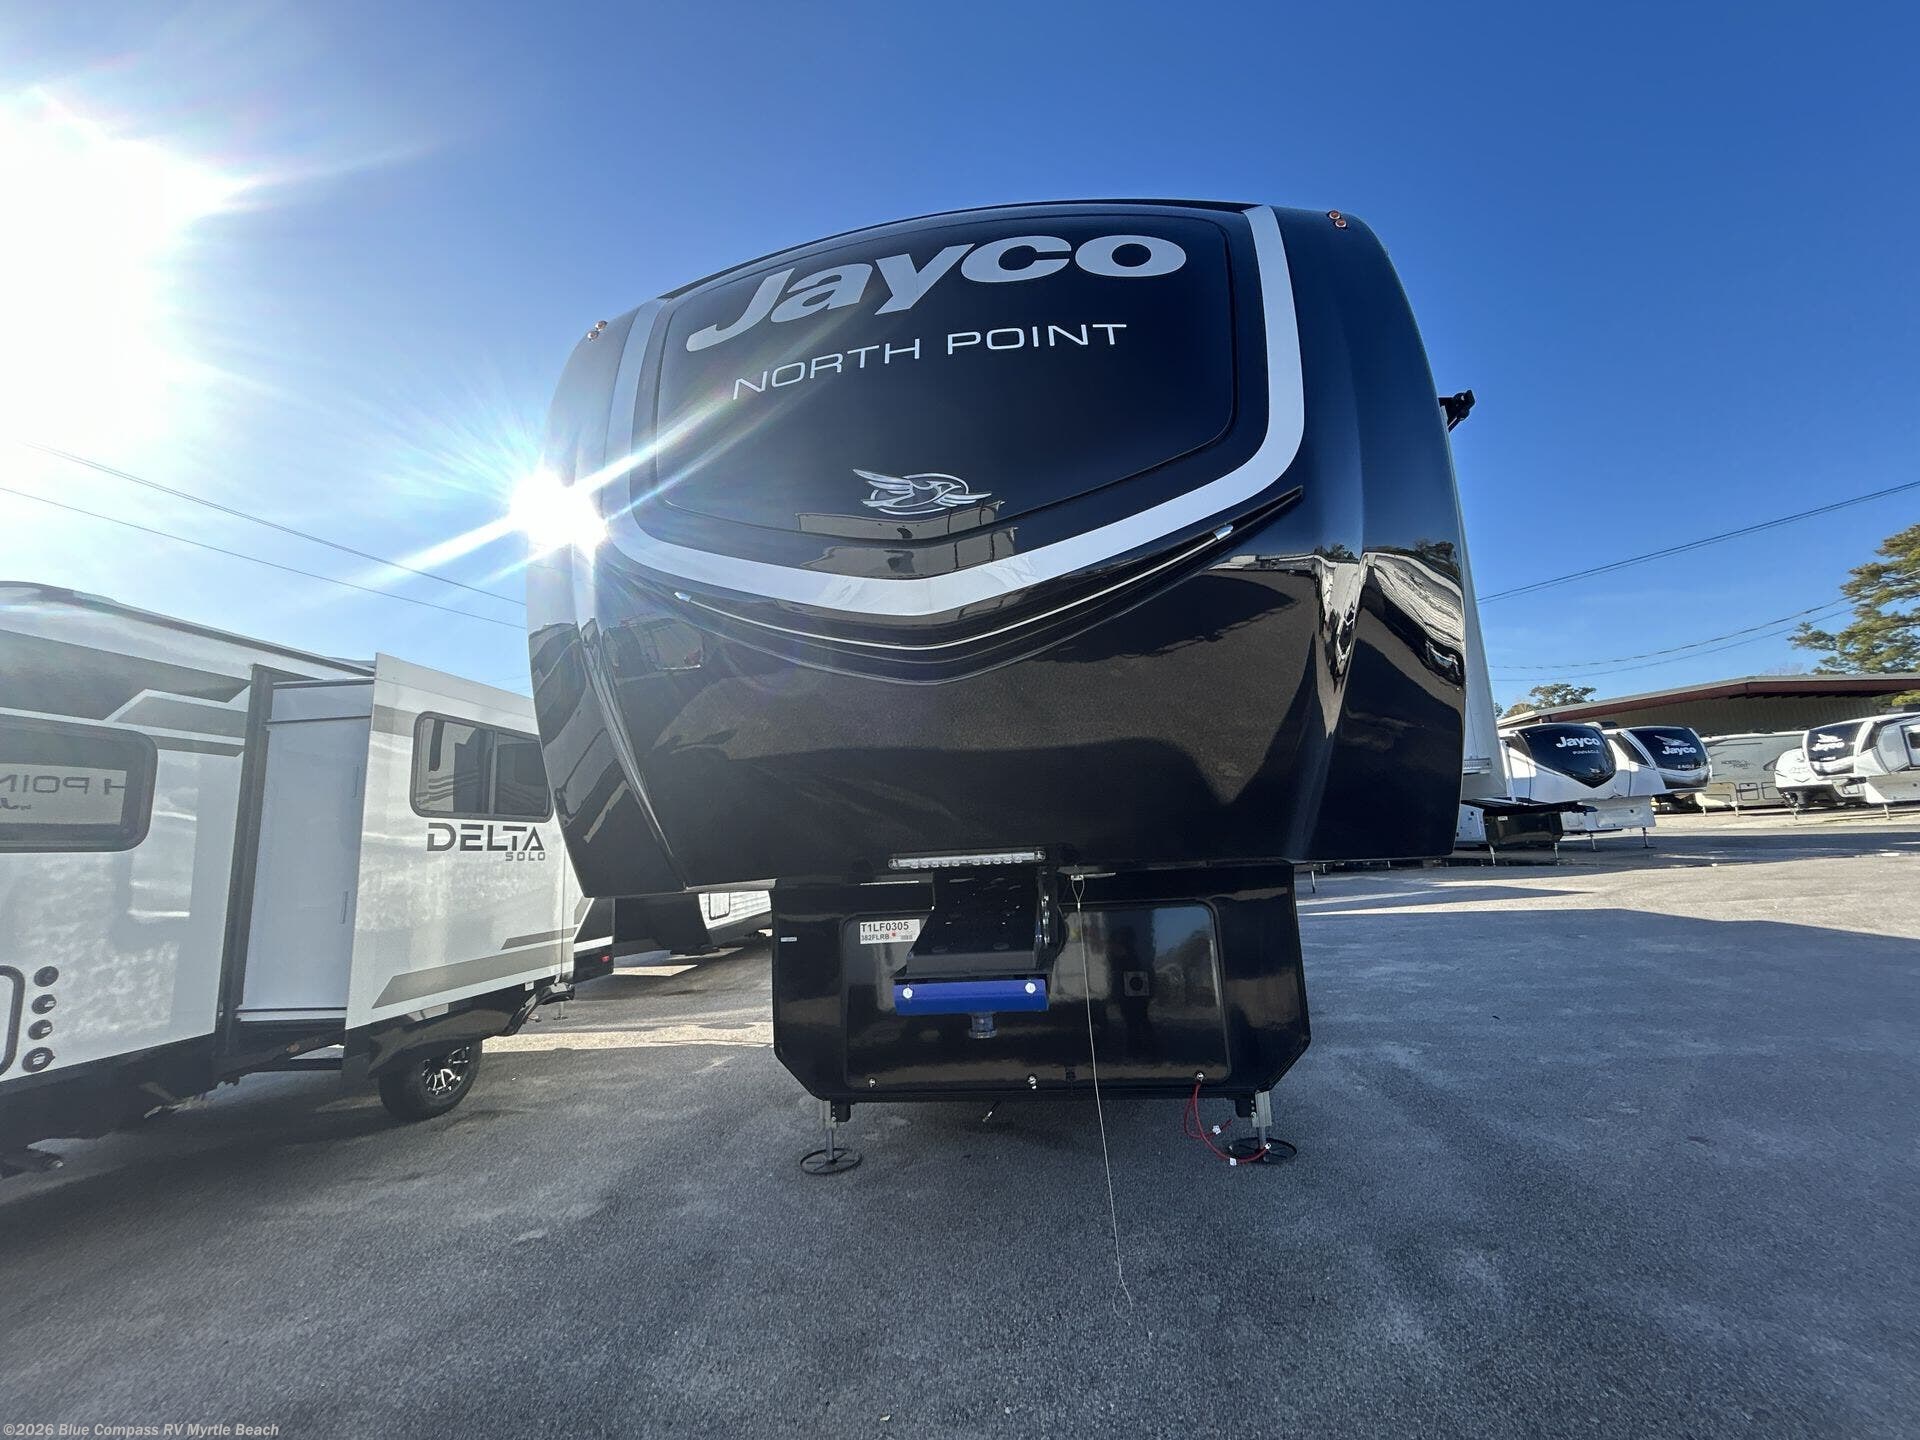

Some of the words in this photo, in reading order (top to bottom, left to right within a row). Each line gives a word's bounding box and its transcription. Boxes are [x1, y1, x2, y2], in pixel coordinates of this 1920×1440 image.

[687, 234, 1187, 353] Jayco
[732, 337, 920, 401] NORTH
[946, 323, 1128, 356] POINT
[1555, 736, 1601, 748] Jayco
[1662, 746, 1697, 756] Jayco
[426, 822, 545, 852] DELTA
[505, 851, 546, 862] SOLO
[861, 922, 909, 932] T1LF0305
